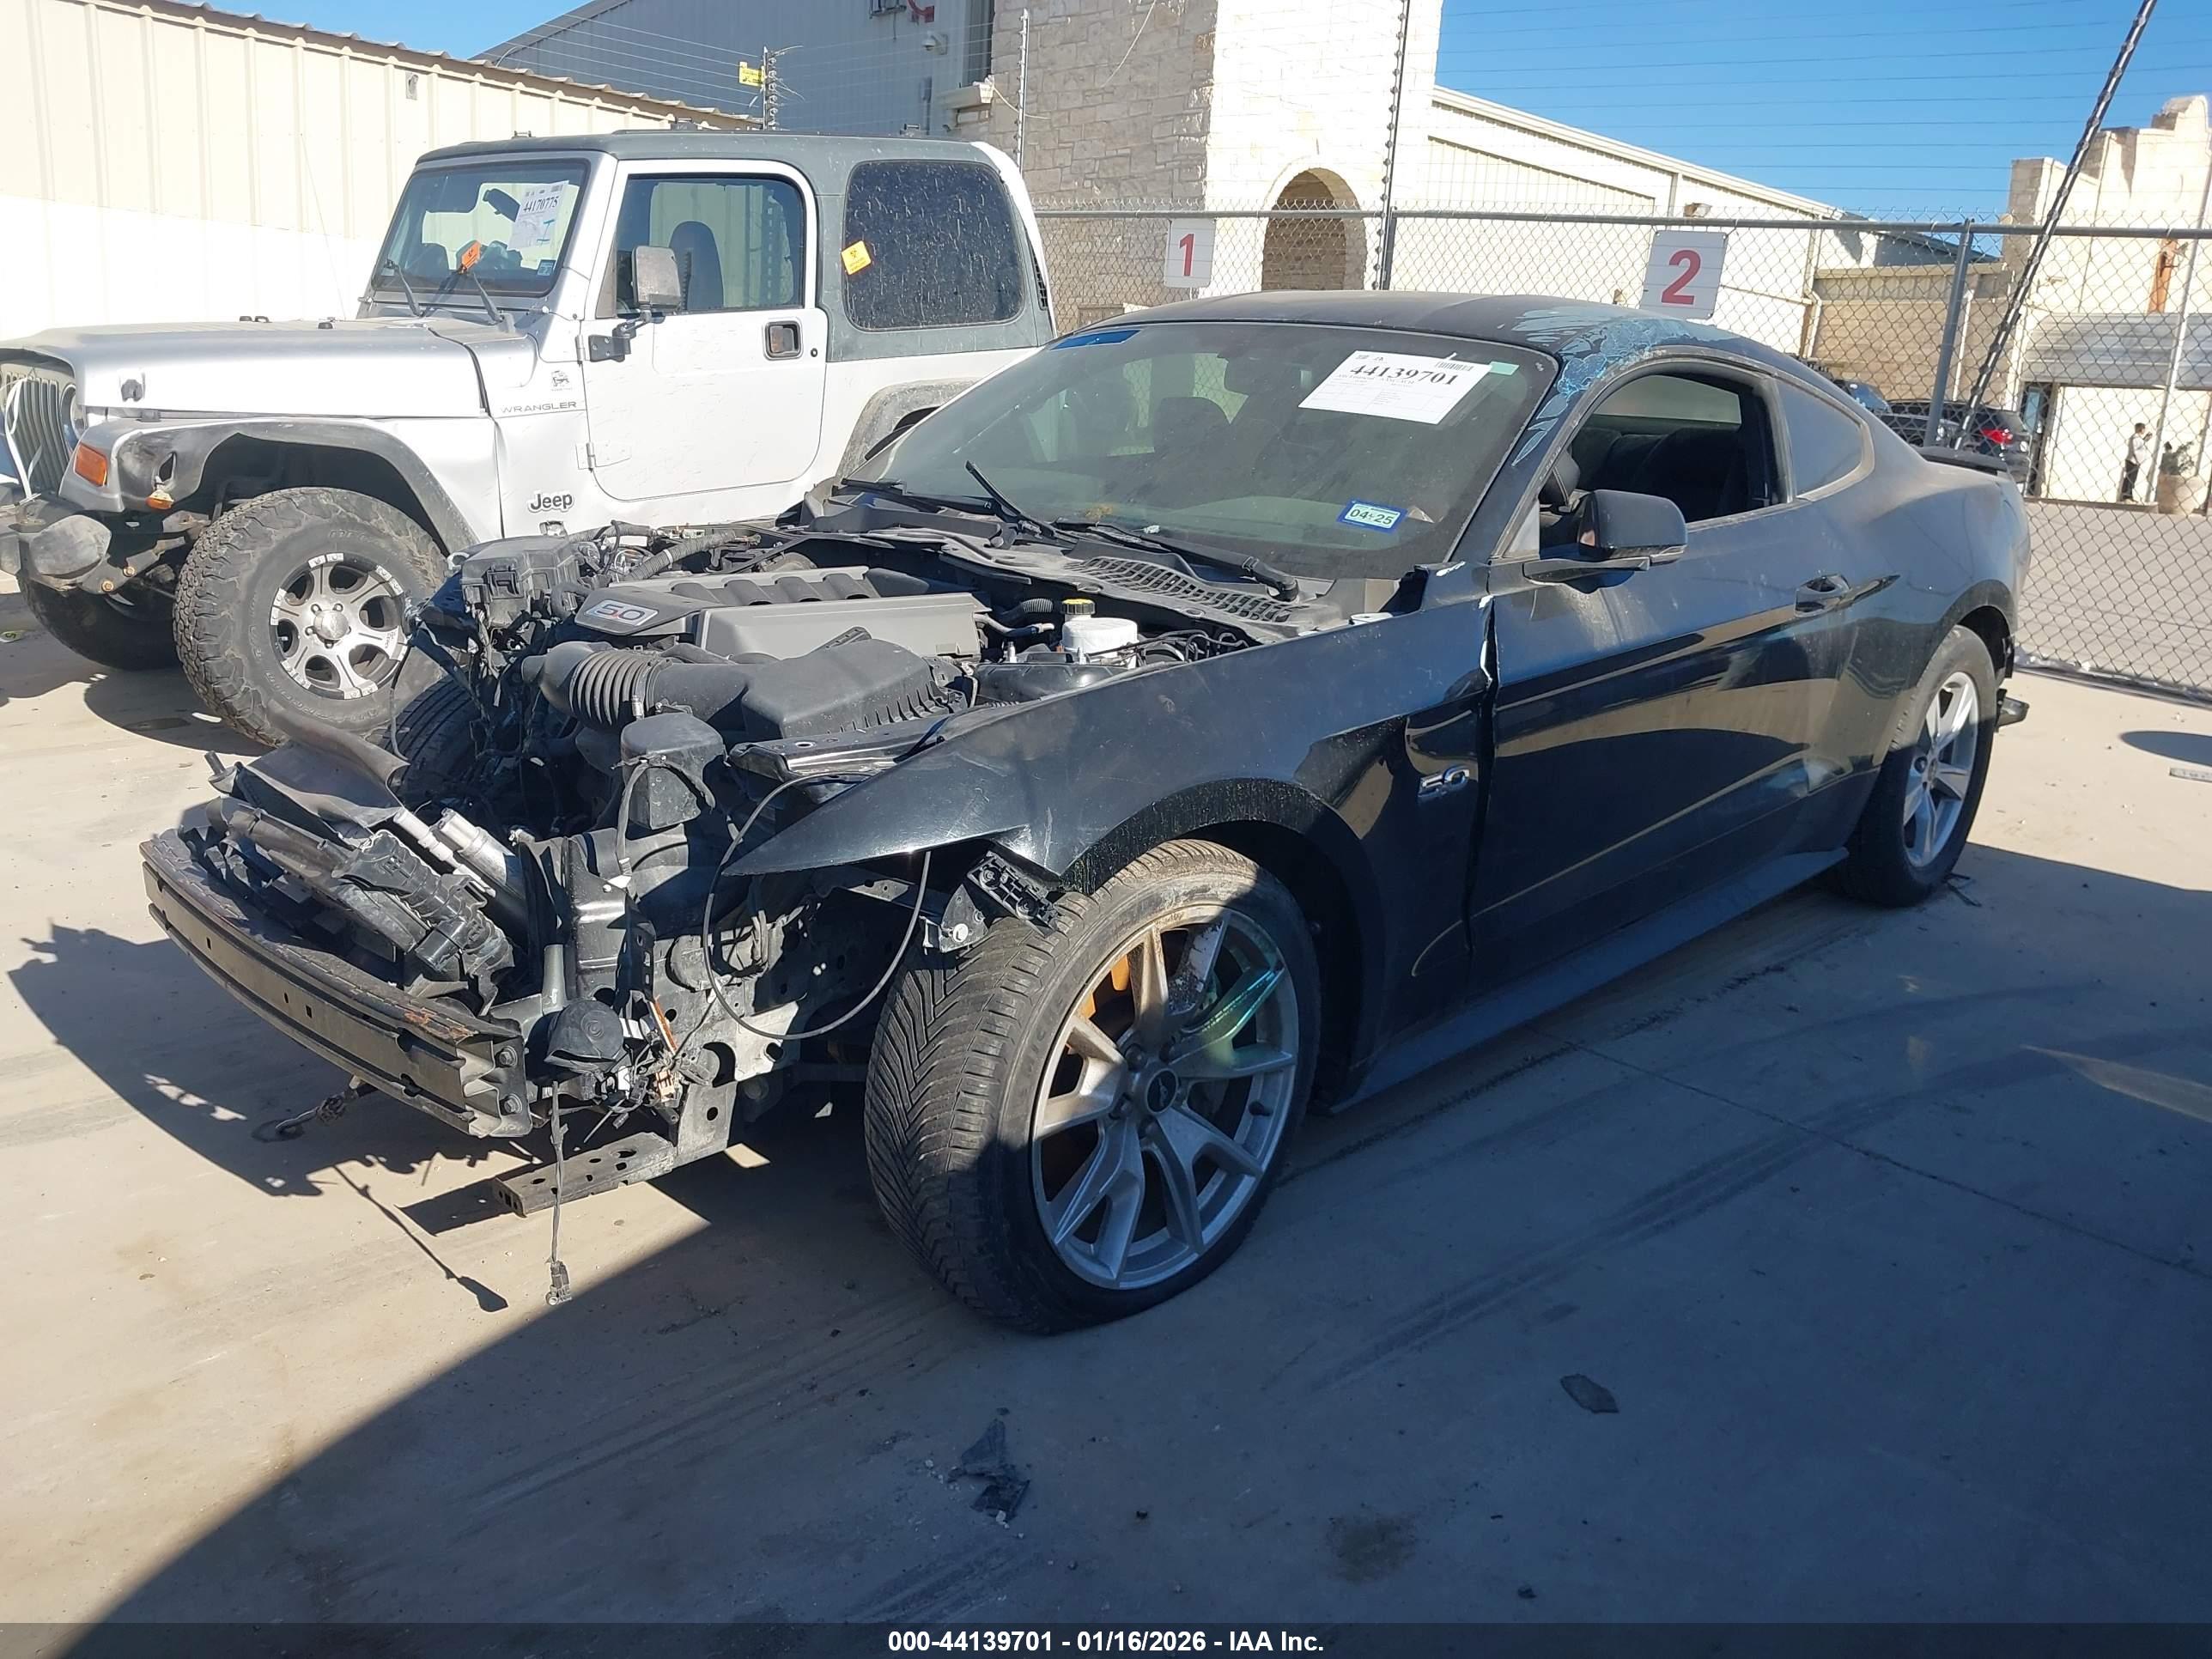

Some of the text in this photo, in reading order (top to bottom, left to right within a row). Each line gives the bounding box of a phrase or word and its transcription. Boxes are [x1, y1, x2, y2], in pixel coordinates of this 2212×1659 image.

[523, 195, 560, 213] 44170775
[1180, 233, 1194, 276] 1
[1661, 249, 1701, 305] 2
[1350, 364, 1459, 386] 44139701
[501, 401, 577, 413] WRANGLER
[530, 493, 573, 510] Jeep
[1350, 509, 1369, 519] 04
[1374, 514, 1395, 525] 25
[597, 604, 646, 620] 5.0
